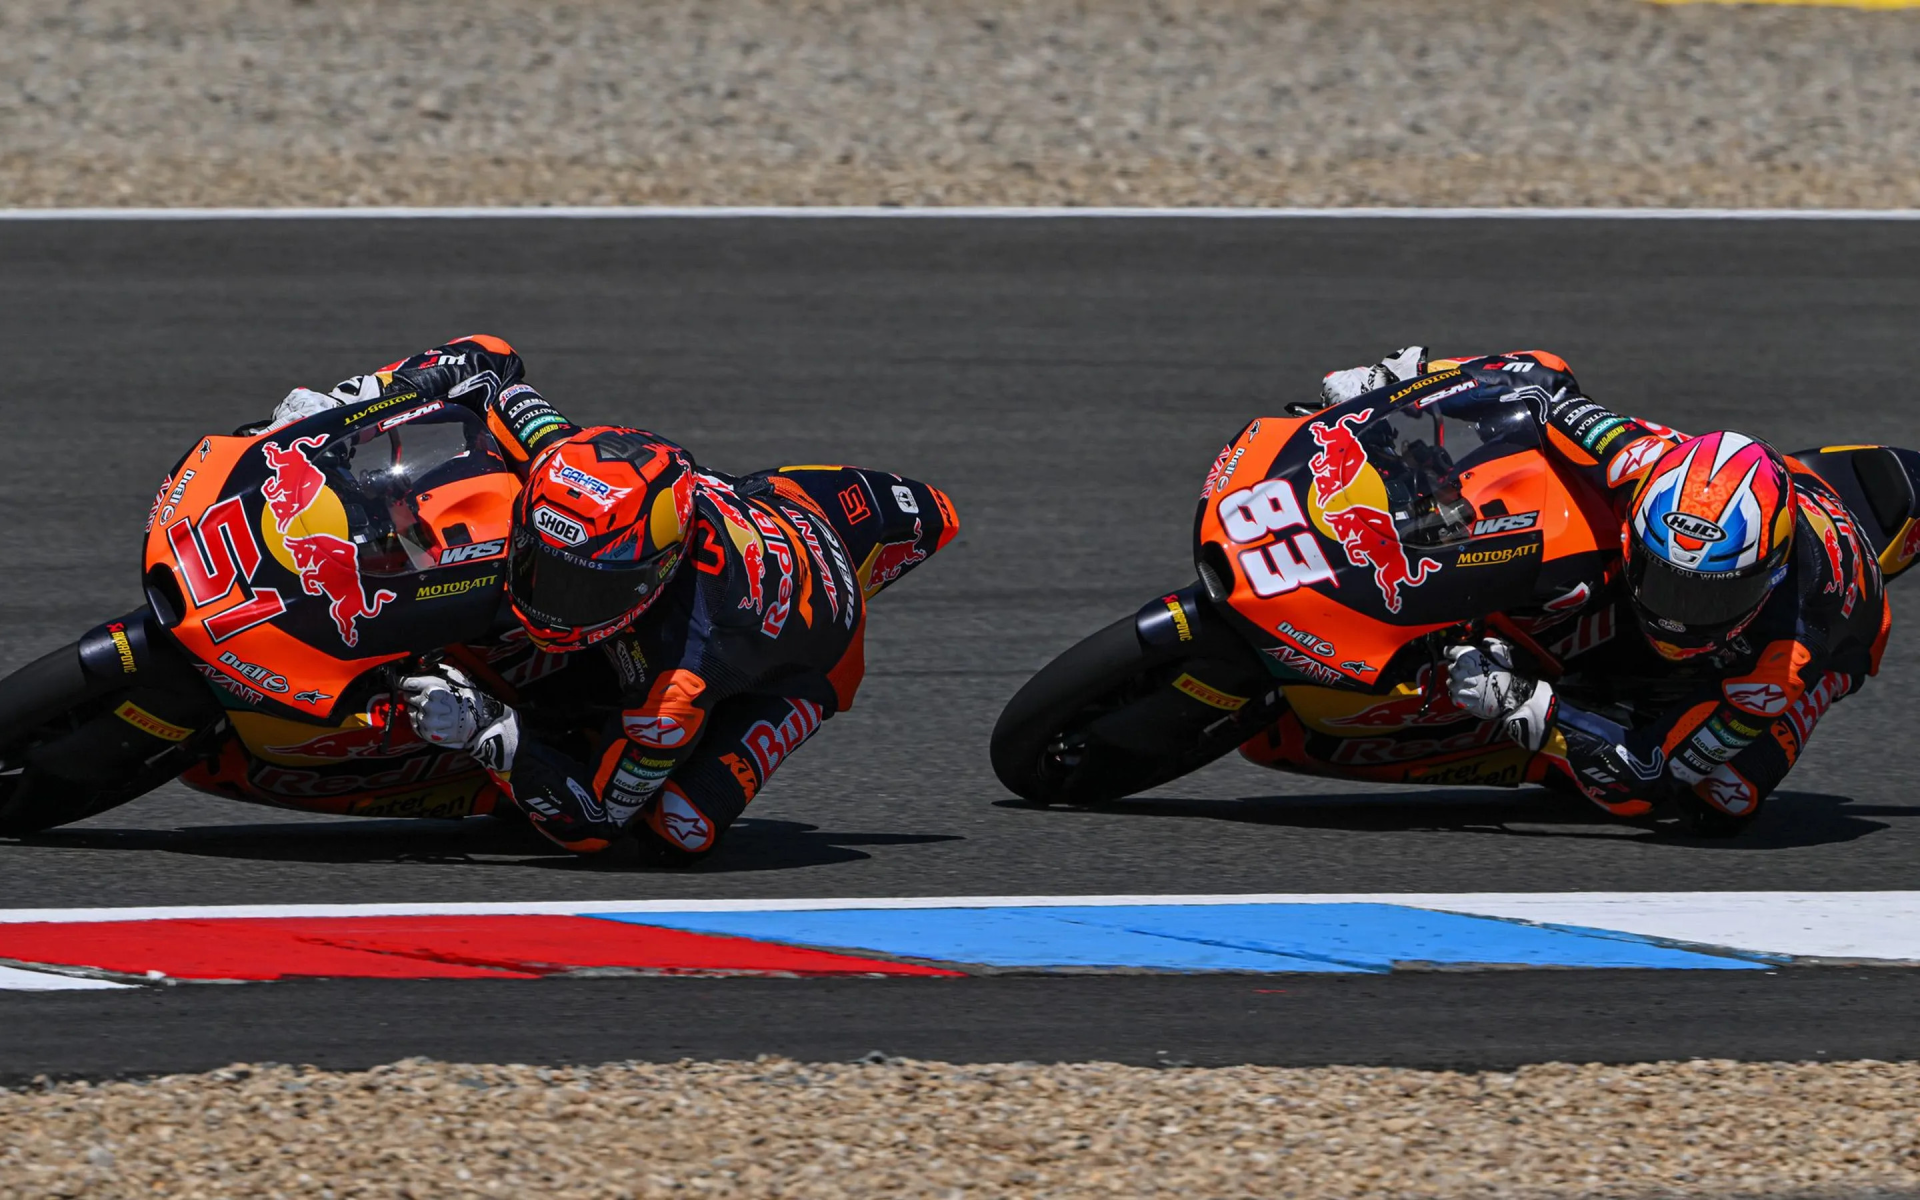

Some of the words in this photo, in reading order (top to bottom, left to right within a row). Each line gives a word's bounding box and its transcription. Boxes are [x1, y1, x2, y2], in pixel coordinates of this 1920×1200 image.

[1389, 368, 1462, 403] MOTOBATT
[344, 392, 418, 426] MOTOBATT
[560, 466, 611, 496] GAHER
[839, 484, 872, 526] 51
[538, 512, 581, 542] SHOEI
[1217, 477, 1340, 599] 83
[1474, 511, 1539, 535] WRS
[1668, 514, 1719, 539] HJC
[440, 538, 505, 565] WRS
[563, 552, 604, 570] WINGS
[780, 506, 839, 624] AVANT
[1456, 542, 1540, 568] MOTOBATT
[167, 495, 287, 645] 51
[1670, 566, 1694, 579] YOU
[1699, 571, 1743, 581] WINGS
[416, 574, 498, 601] MOTOBATT
[760, 539, 793, 640] Red
[587, 613, 631, 645] Red
[1261, 645, 1345, 686] AVANT
[194, 662, 264, 706] AVANT
[1180, 678, 1242, 708] PIRELLI
[123, 706, 187, 739] PIRELLI
[741, 697, 823, 786] Bull
[1328, 720, 1502, 767] Red
[251, 756, 430, 797] Red
[719, 752, 759, 805] KTM
